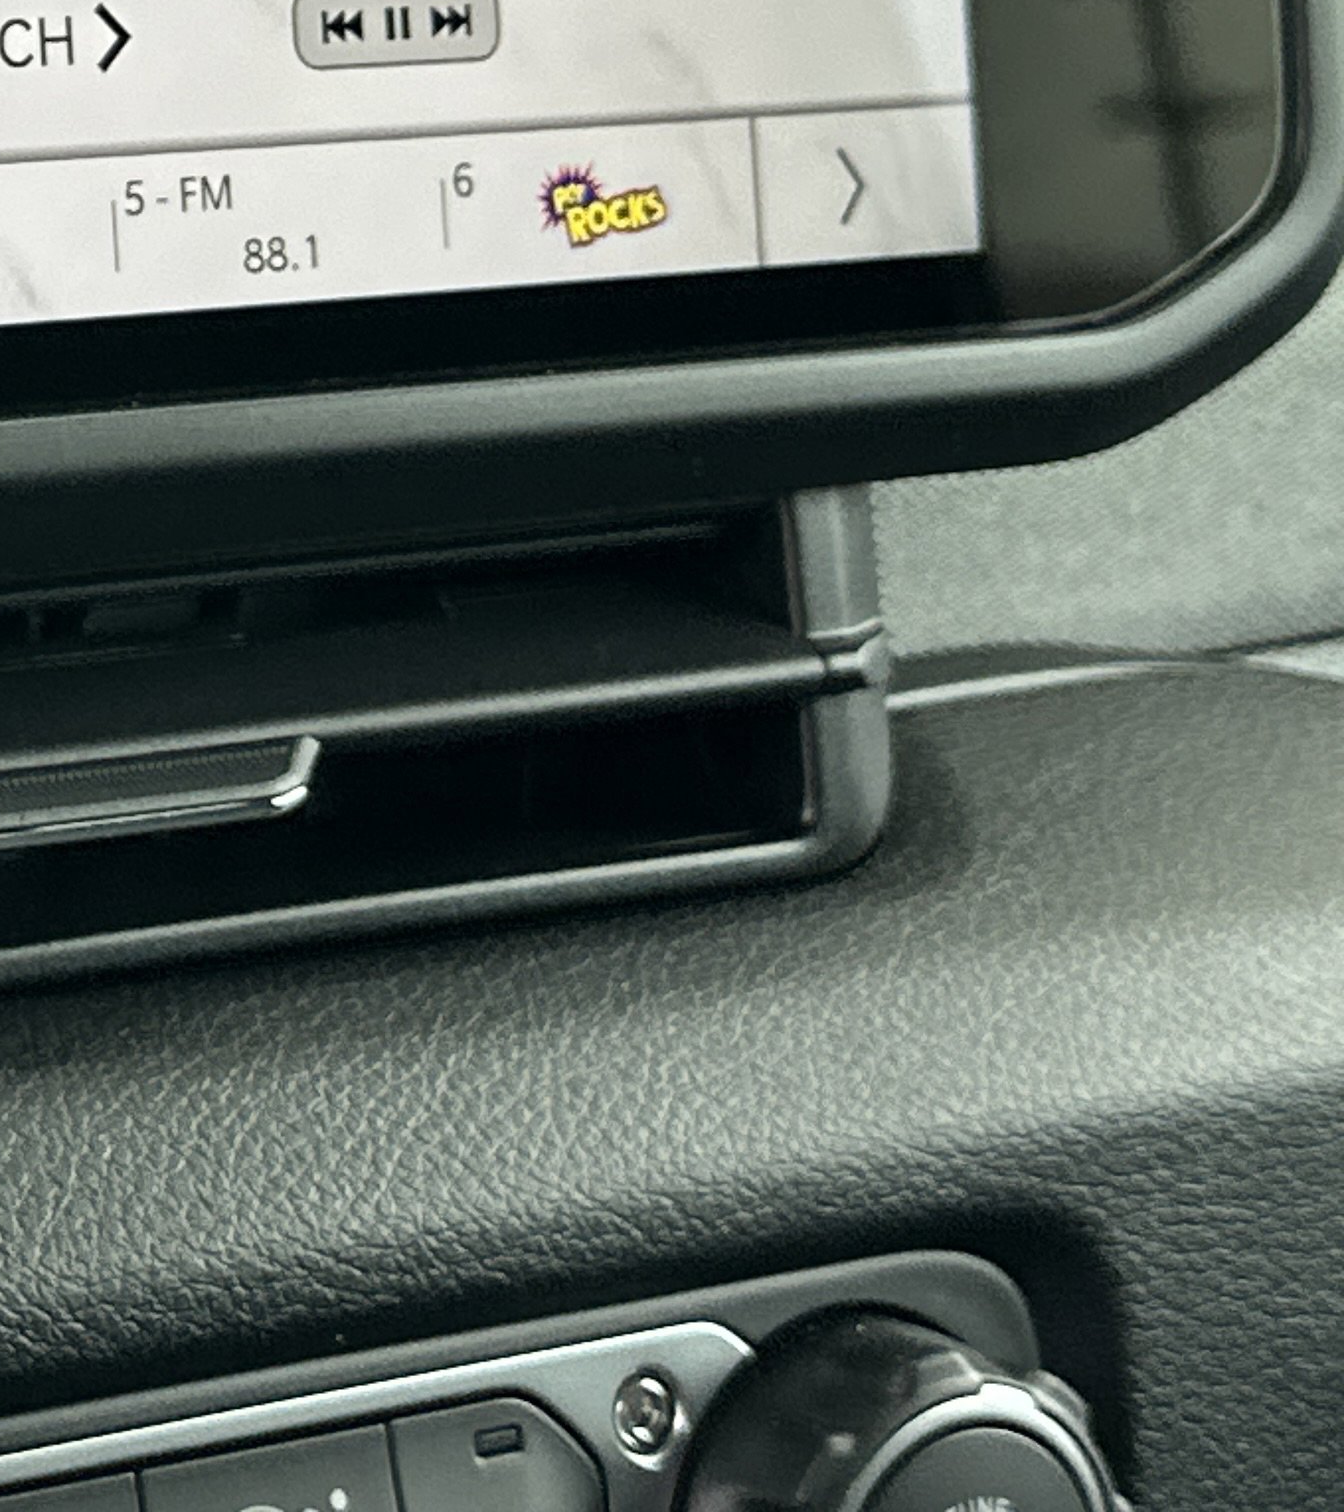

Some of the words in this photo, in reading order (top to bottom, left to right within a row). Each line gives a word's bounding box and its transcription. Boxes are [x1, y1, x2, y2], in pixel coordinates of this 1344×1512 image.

[125, 179, 145, 217] 5
[180, 174, 232, 212] FM
[452, 161, 474, 198] 6
[566, 190, 666, 245] ROCKS
[243, 234, 318, 274] 88.1
